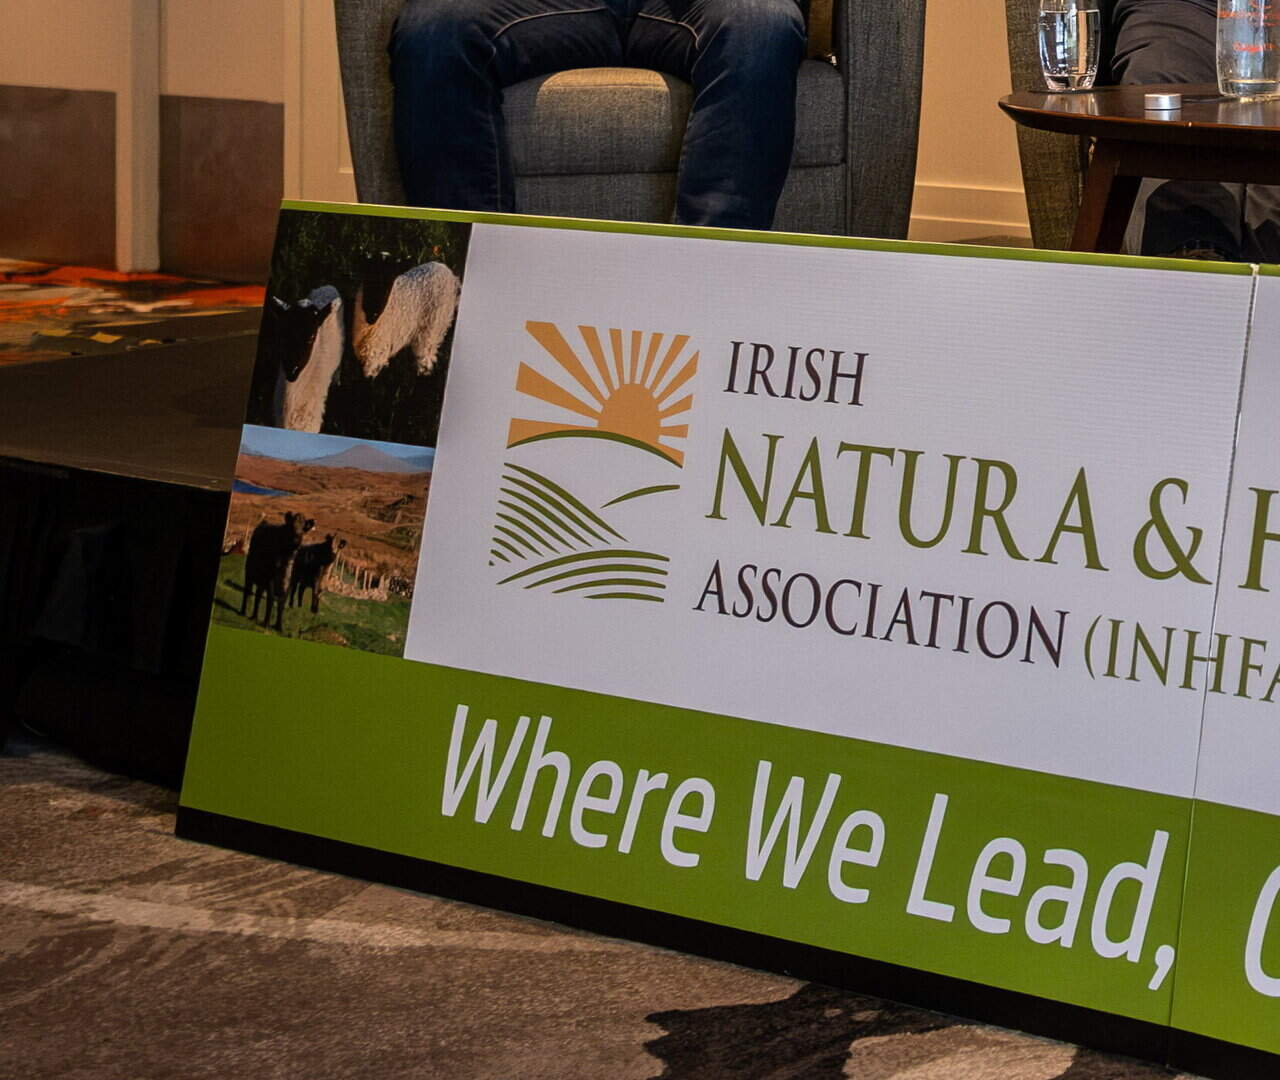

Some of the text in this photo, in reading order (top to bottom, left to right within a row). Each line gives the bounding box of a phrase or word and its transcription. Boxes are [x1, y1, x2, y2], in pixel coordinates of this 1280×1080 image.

[723, 340, 869, 407] IRISH
[704, 426, 1109, 572] NATURA
[1132, 476, 1214, 585] &
[691, 557, 1070, 669] ASSOCIATION
[441, 703, 716, 869] Where
[744, 759, 886, 905] We
[904, 792, 1176, 992] Lead,
